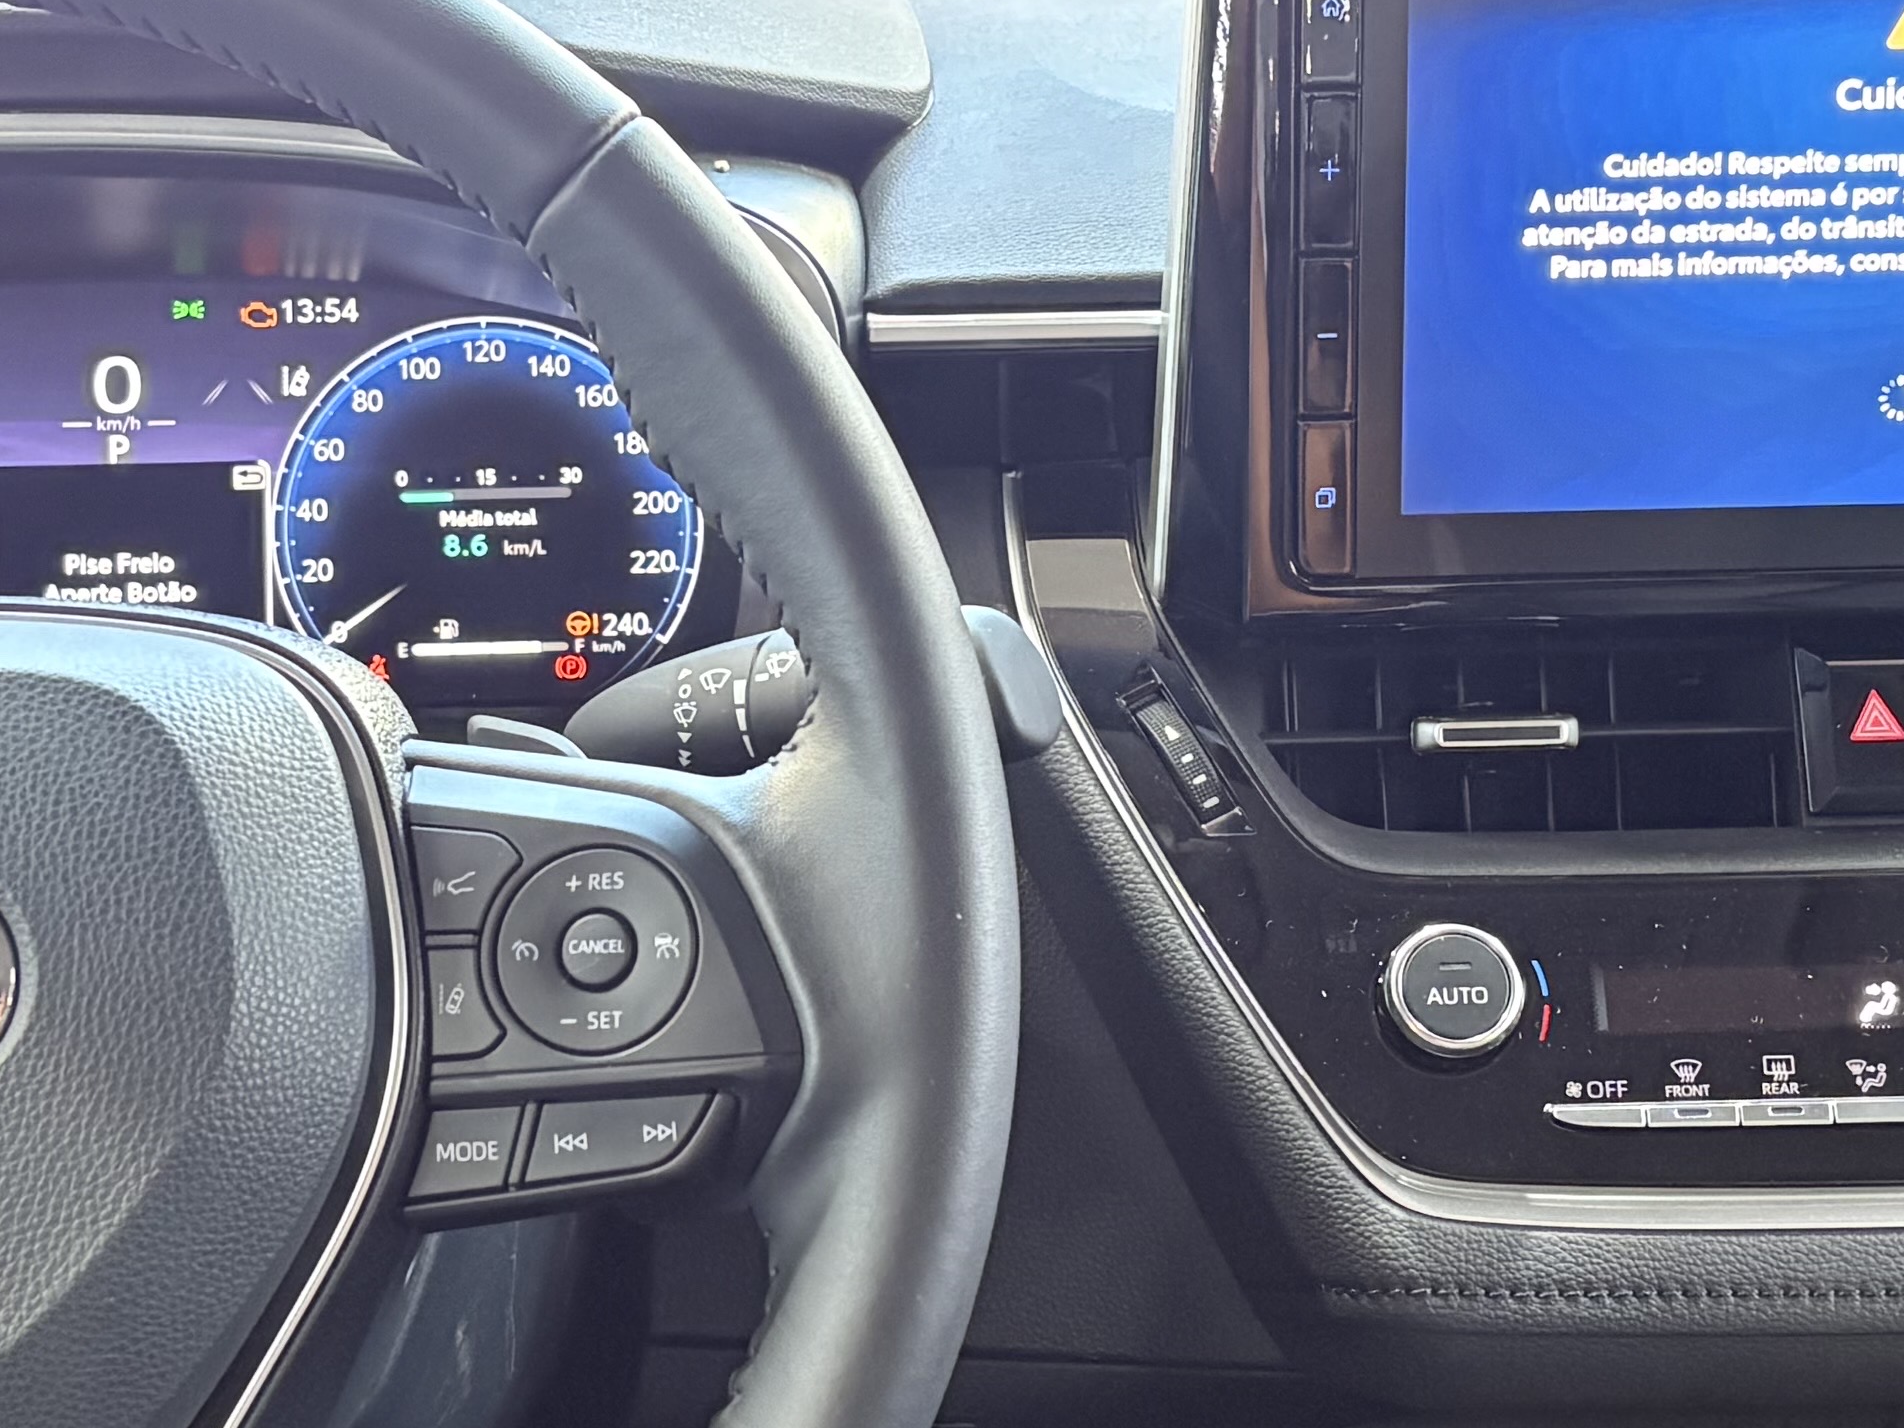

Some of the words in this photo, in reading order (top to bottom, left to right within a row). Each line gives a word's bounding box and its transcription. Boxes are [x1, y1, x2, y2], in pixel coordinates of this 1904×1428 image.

[1604, 151, 1723, 178] Cuidado!
[1728, 149, 1841, 179] Respeite
[1529, 188, 1551, 214] A
[1555, 186, 1682, 217] utilização
[1685, 184, 1722, 211] do
[1726, 183, 1826, 209] sistema
[1831, 181, 1848, 207] é
[1852, 183, 1899, 211] por
[1522, 220, 1628, 250] atenção
[1631, 218, 1666, 245] da
[1670, 216, 1776, 244] estrada,
[1780, 215, 1817, 240] do
[1550, 254, 1607, 280] Para
[1611, 252, 1674, 278] mais
[1677, 248, 1845, 280] informações,
[281, 297, 360, 325] 13:54
[463, 339, 506, 364] 120
[399, 356, 441, 380] 100
[527, 353, 571, 378] 140
[94, 355, 143, 414] 0
[575, 384, 619, 408] 160
[352, 388, 384, 413] 80
[96, 416, 142, 434] km/h
[109, 435, 131, 465] P
[313, 438, 345, 462] 60
[395, 470, 409, 488] 0
[476, 468, 497, 486] 15
[559, 466, 583, 485] 30
[296, 498, 329, 522] 40
[633, 490, 679, 515] 200
[439, 507, 493, 528] Média
[495, 507, 538, 526] total
[443, 533, 489, 558] 8.6
[503, 538, 547, 557] km/L
[64, 553, 113, 576] Pise
[116, 551, 176, 575] Freio
[302, 557, 334, 583] 20
[630, 550, 676, 575] 220
[127, 580, 197, 604] Botão
[330, 620, 348, 643] 0
[603, 612, 648, 637] 240
[397, 643, 409, 658] E
[574, 640, 585, 654] F
[592, 638, 626, 654] km/h
[587, 871, 624, 891] RES
[568, 938, 625, 956] CANCEL
[1427, 985, 1489, 1006] AUTO
[587, 1011, 623, 1031] SET
[1586, 1079, 1629, 1099] OFF
[1664, 1082, 1712, 1099] FRONT
[1761, 1081, 1801, 1097] REAR
[436, 1139, 500, 1163] MODE
